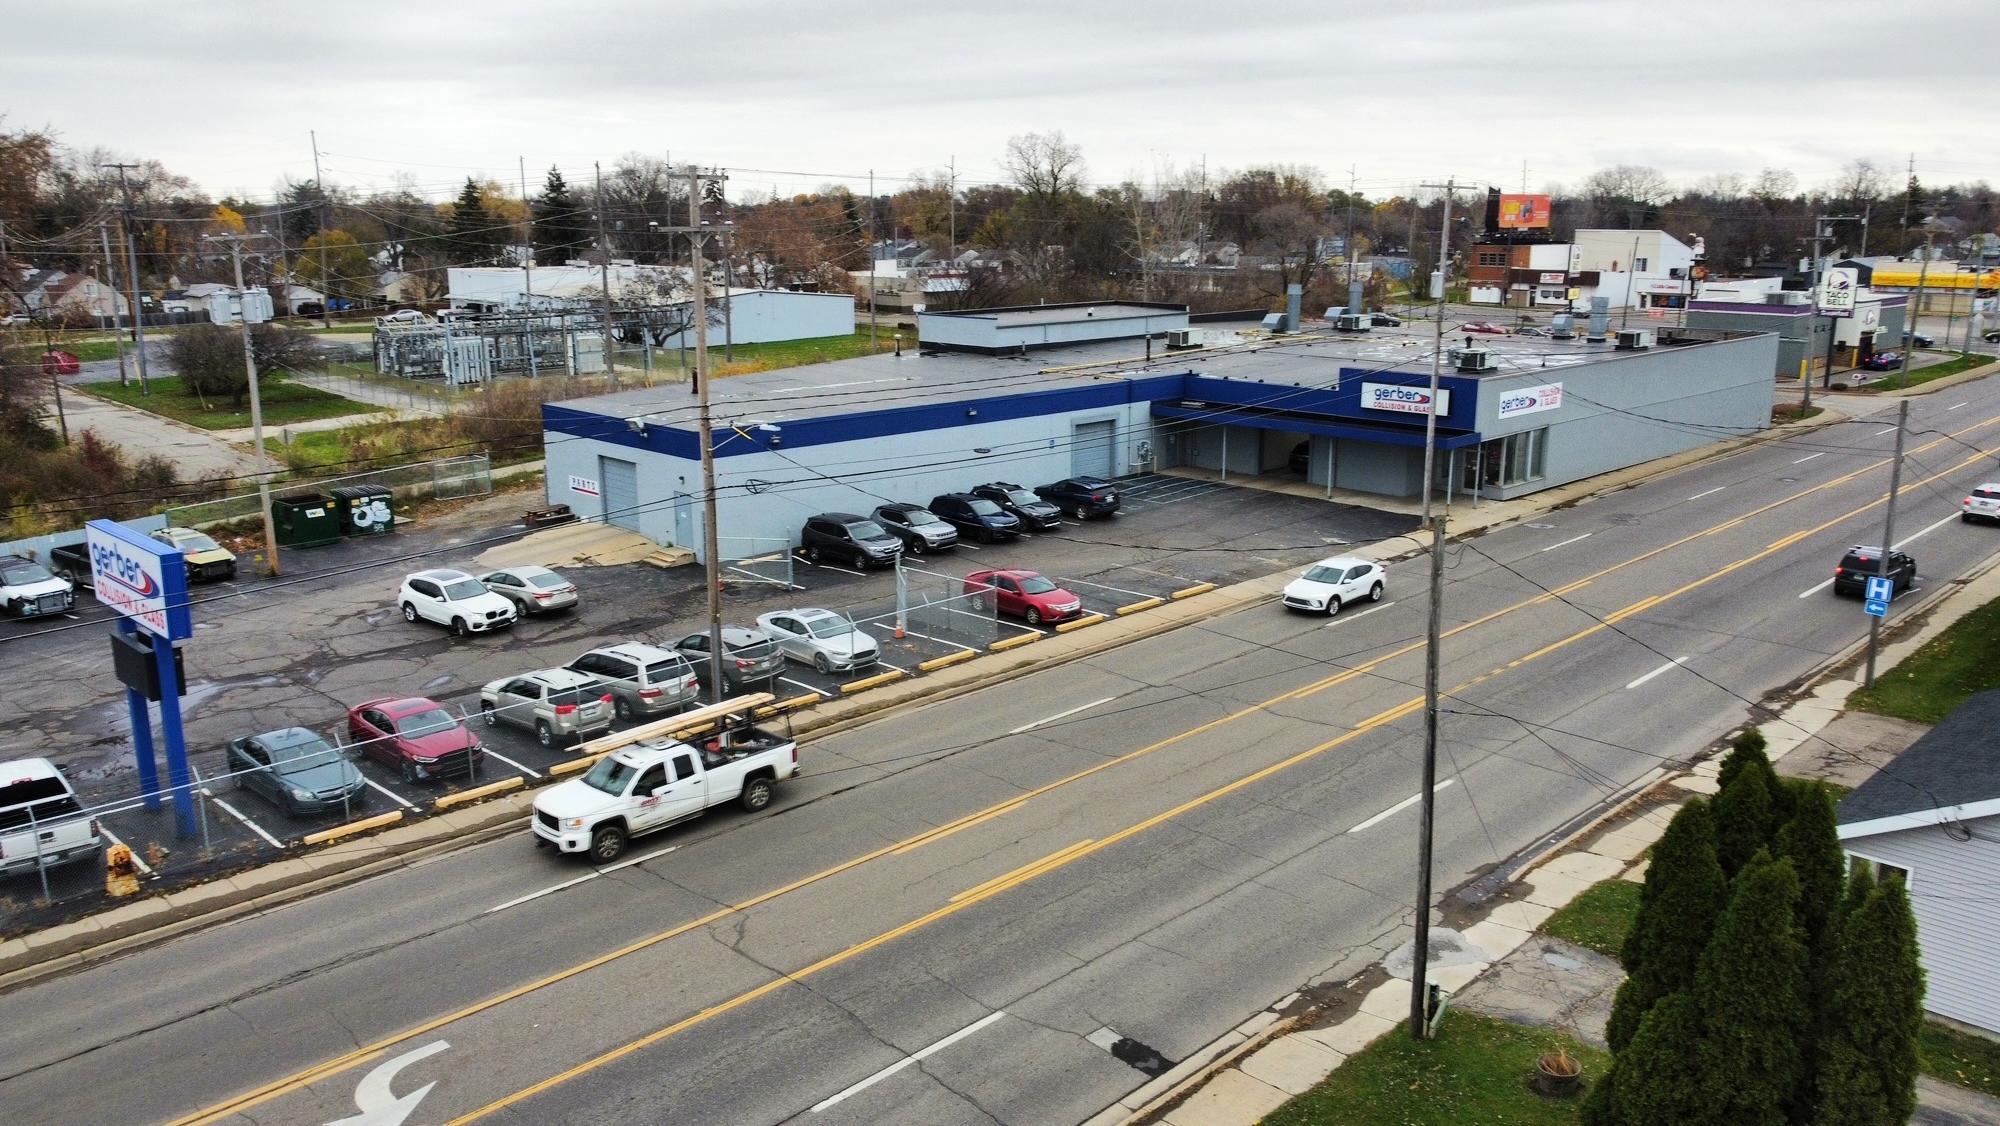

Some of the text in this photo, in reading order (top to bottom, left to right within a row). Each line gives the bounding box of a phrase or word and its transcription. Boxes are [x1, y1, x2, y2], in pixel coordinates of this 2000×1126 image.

[1826, 291, 1849, 299] TACO
[1374, 387, 1419, 401] gerber
[1373, 401, 1406, 411] COLLISION
[1502, 395, 1529, 414] gerber
[93, 542, 140, 585] gerber
[1869, 578, 1890, 600] H
